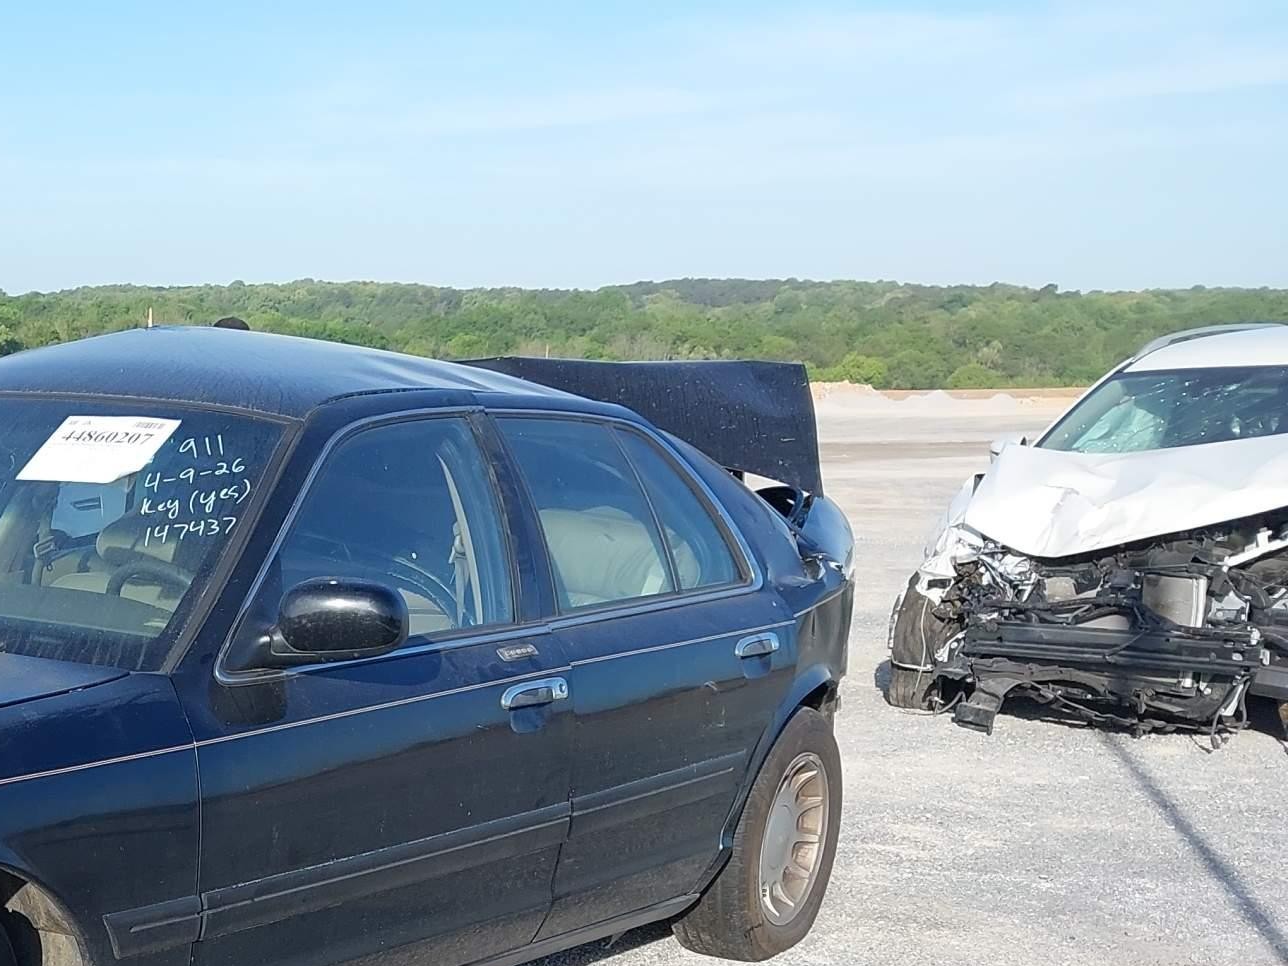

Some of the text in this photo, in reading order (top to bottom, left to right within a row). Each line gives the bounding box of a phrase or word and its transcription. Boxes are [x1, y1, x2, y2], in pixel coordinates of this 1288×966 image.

[62, 430, 155, 445] 44860207
[144, 458, 245, 493] 4-9-26
[189, 479, 251, 514] (yes)
[144, 517, 237, 547] 147437
